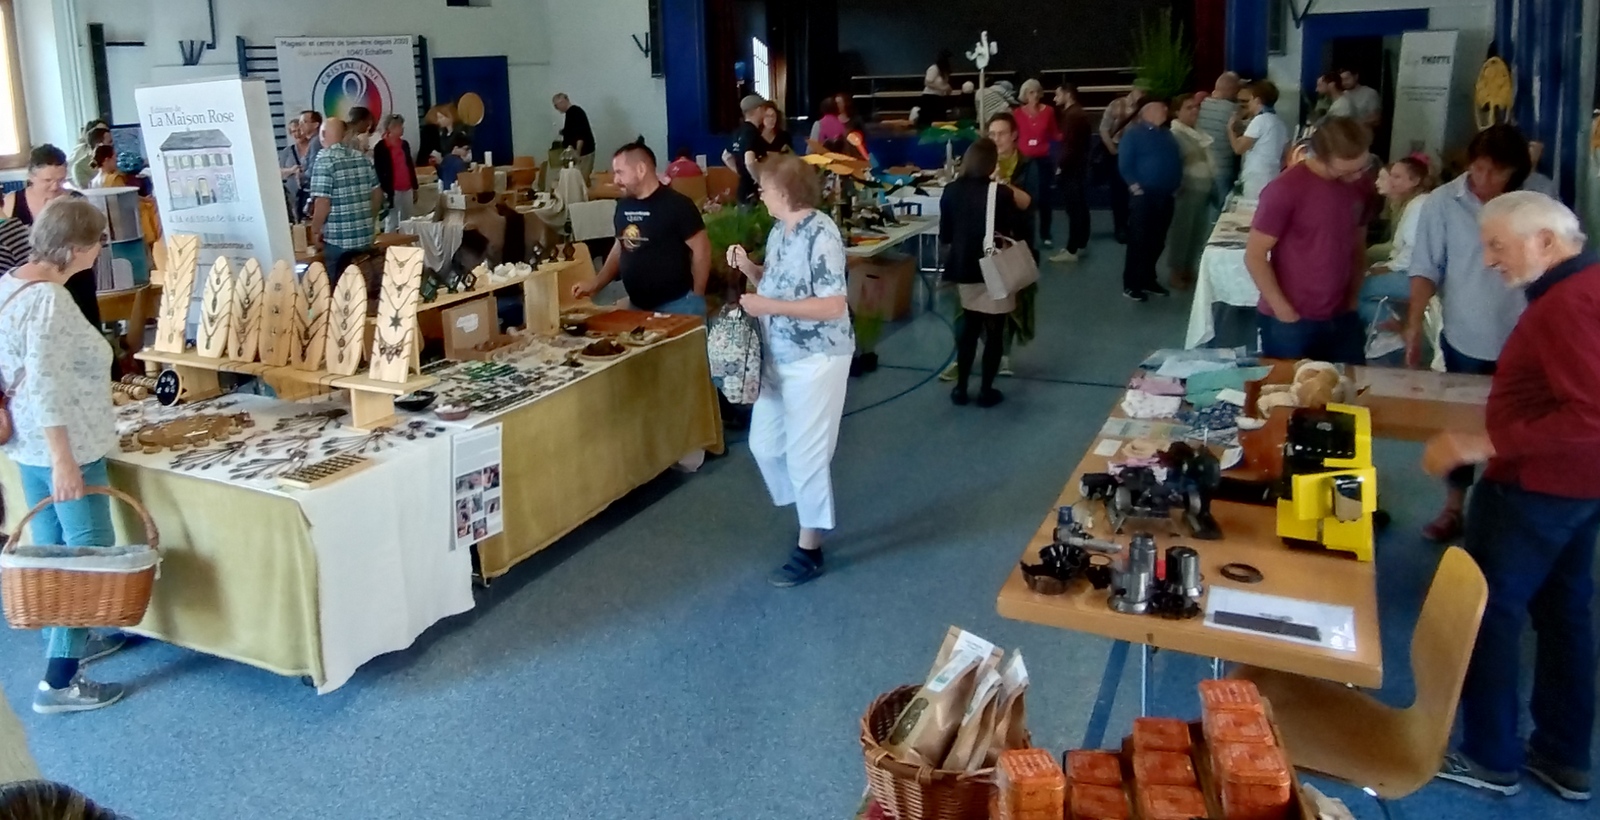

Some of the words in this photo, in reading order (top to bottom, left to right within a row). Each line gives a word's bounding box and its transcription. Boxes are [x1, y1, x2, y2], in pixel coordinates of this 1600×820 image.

[280, 40, 307, 48] Magasin
[148, 113, 164, 128] La
[164, 111, 207, 127] Maison
[207, 109, 235, 124] Rose
